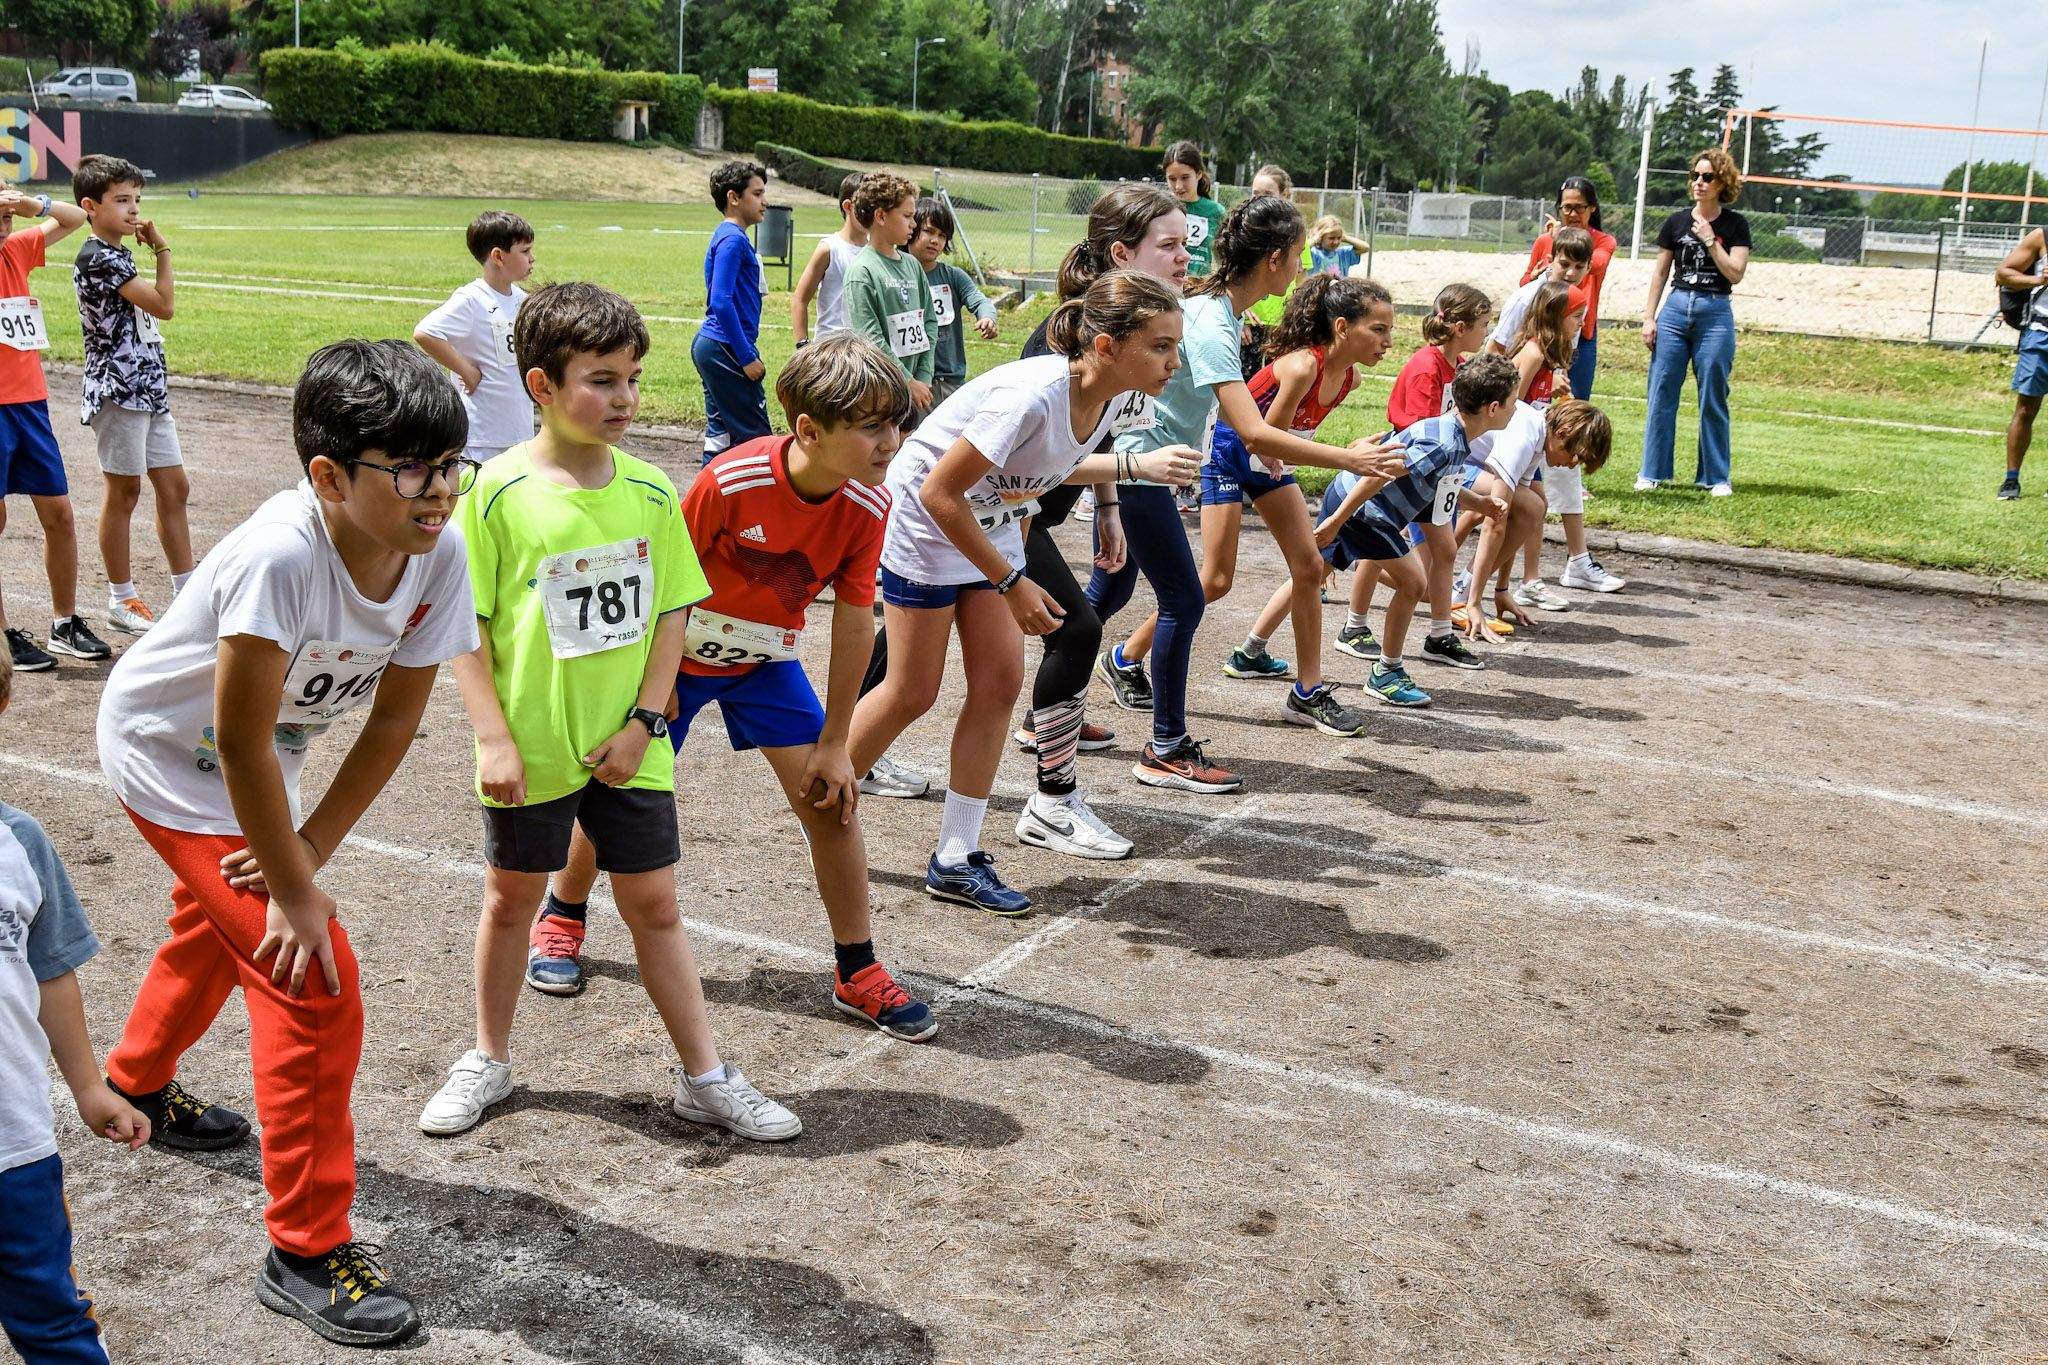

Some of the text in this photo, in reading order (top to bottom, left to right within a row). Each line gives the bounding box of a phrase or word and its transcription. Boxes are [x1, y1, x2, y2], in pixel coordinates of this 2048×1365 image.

[1, 314, 36, 338] 915
[897, 324, 923, 346] 739
[985, 474, 1044, 490] SANTA
[1218, 483, 1240, 492] ADM
[1443, 491, 1456, 513] 8
[740, 531, 766, 543] adidas
[565, 574, 641, 631] 787
[294, 664, 386, 707] 916
